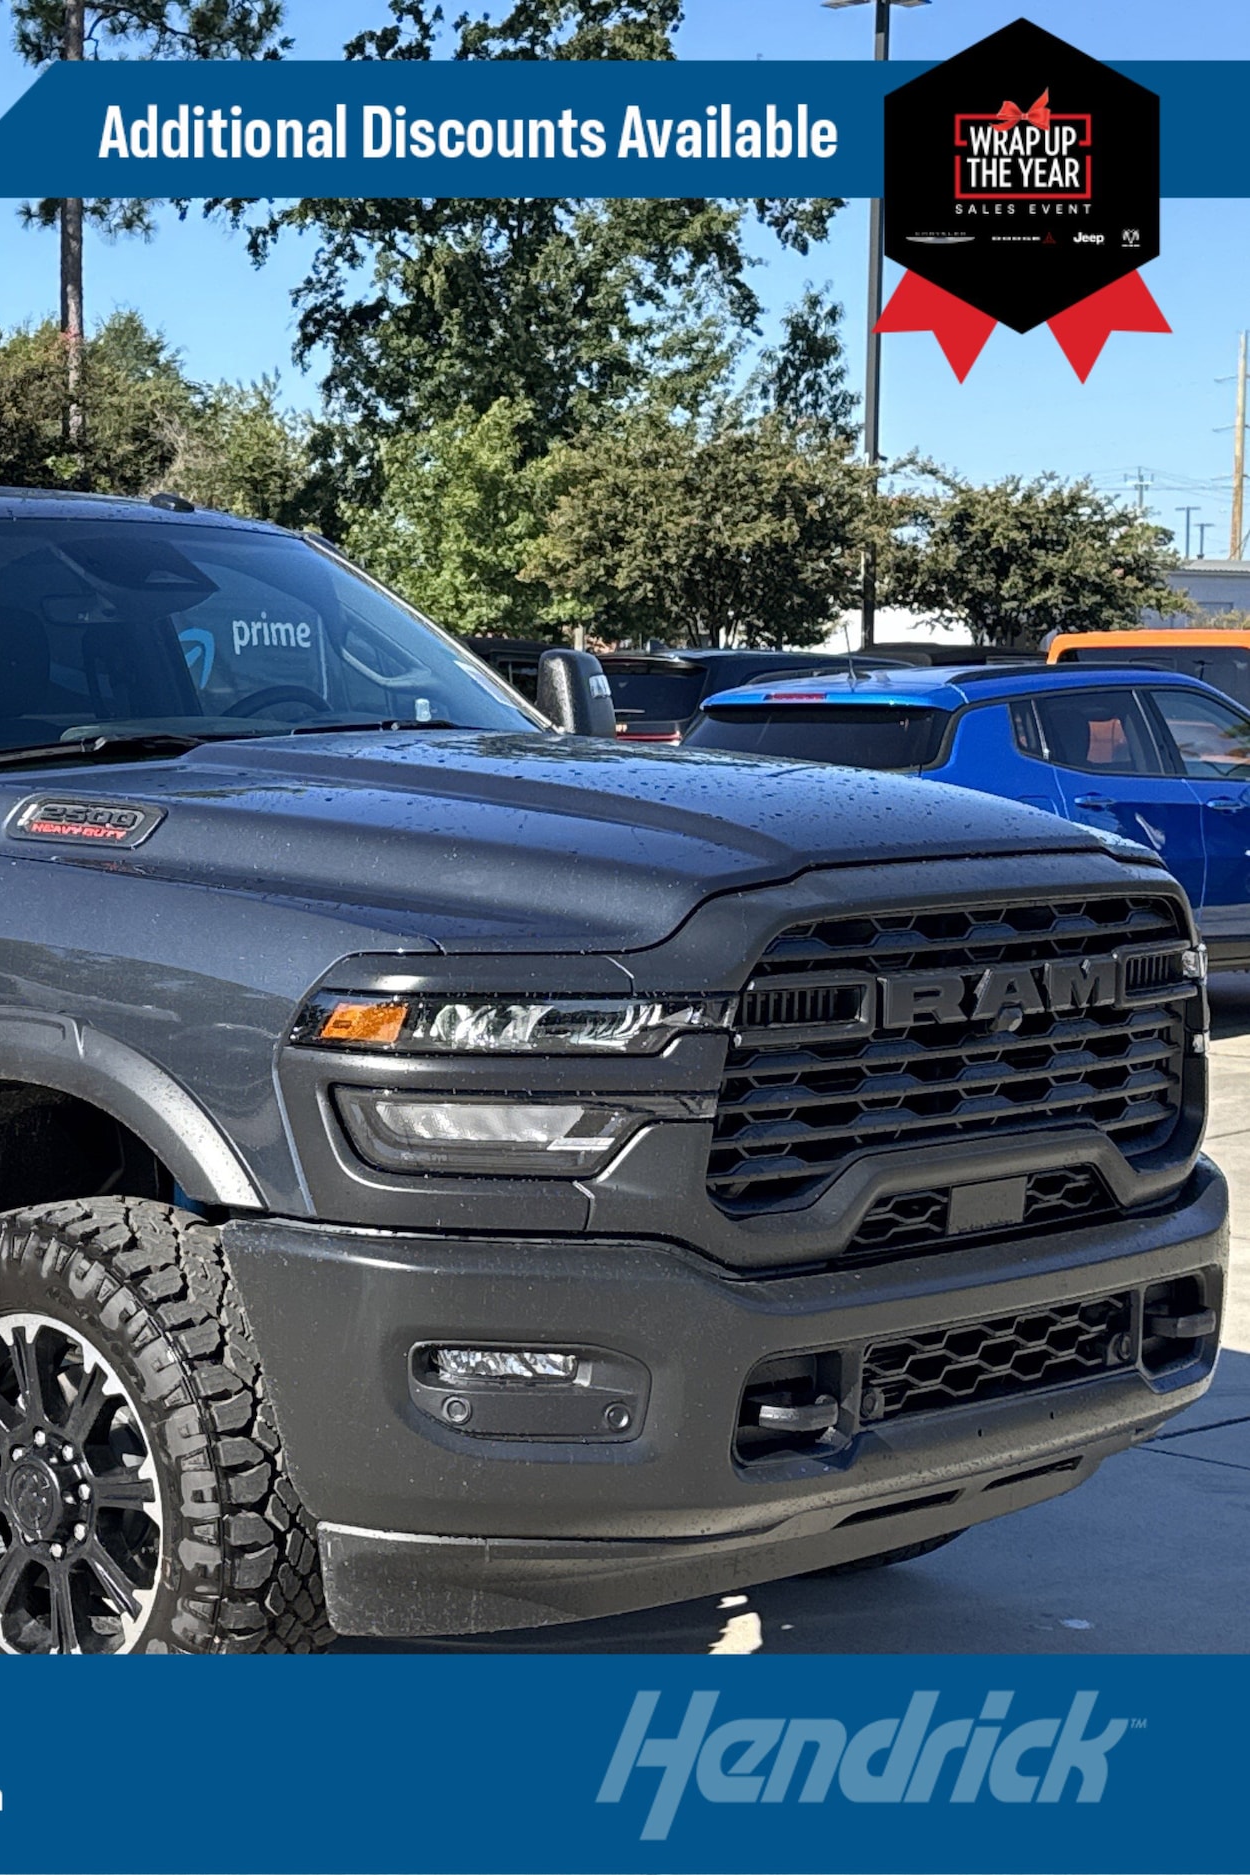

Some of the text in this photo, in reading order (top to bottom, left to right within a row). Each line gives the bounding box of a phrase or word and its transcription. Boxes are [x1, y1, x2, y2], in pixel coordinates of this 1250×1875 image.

[232, 611, 311, 655] prime
[31, 821, 127, 840] HEAVY DUTY
[39, 806, 138, 829] 2500
[876, 956, 1117, 1029] RAM
